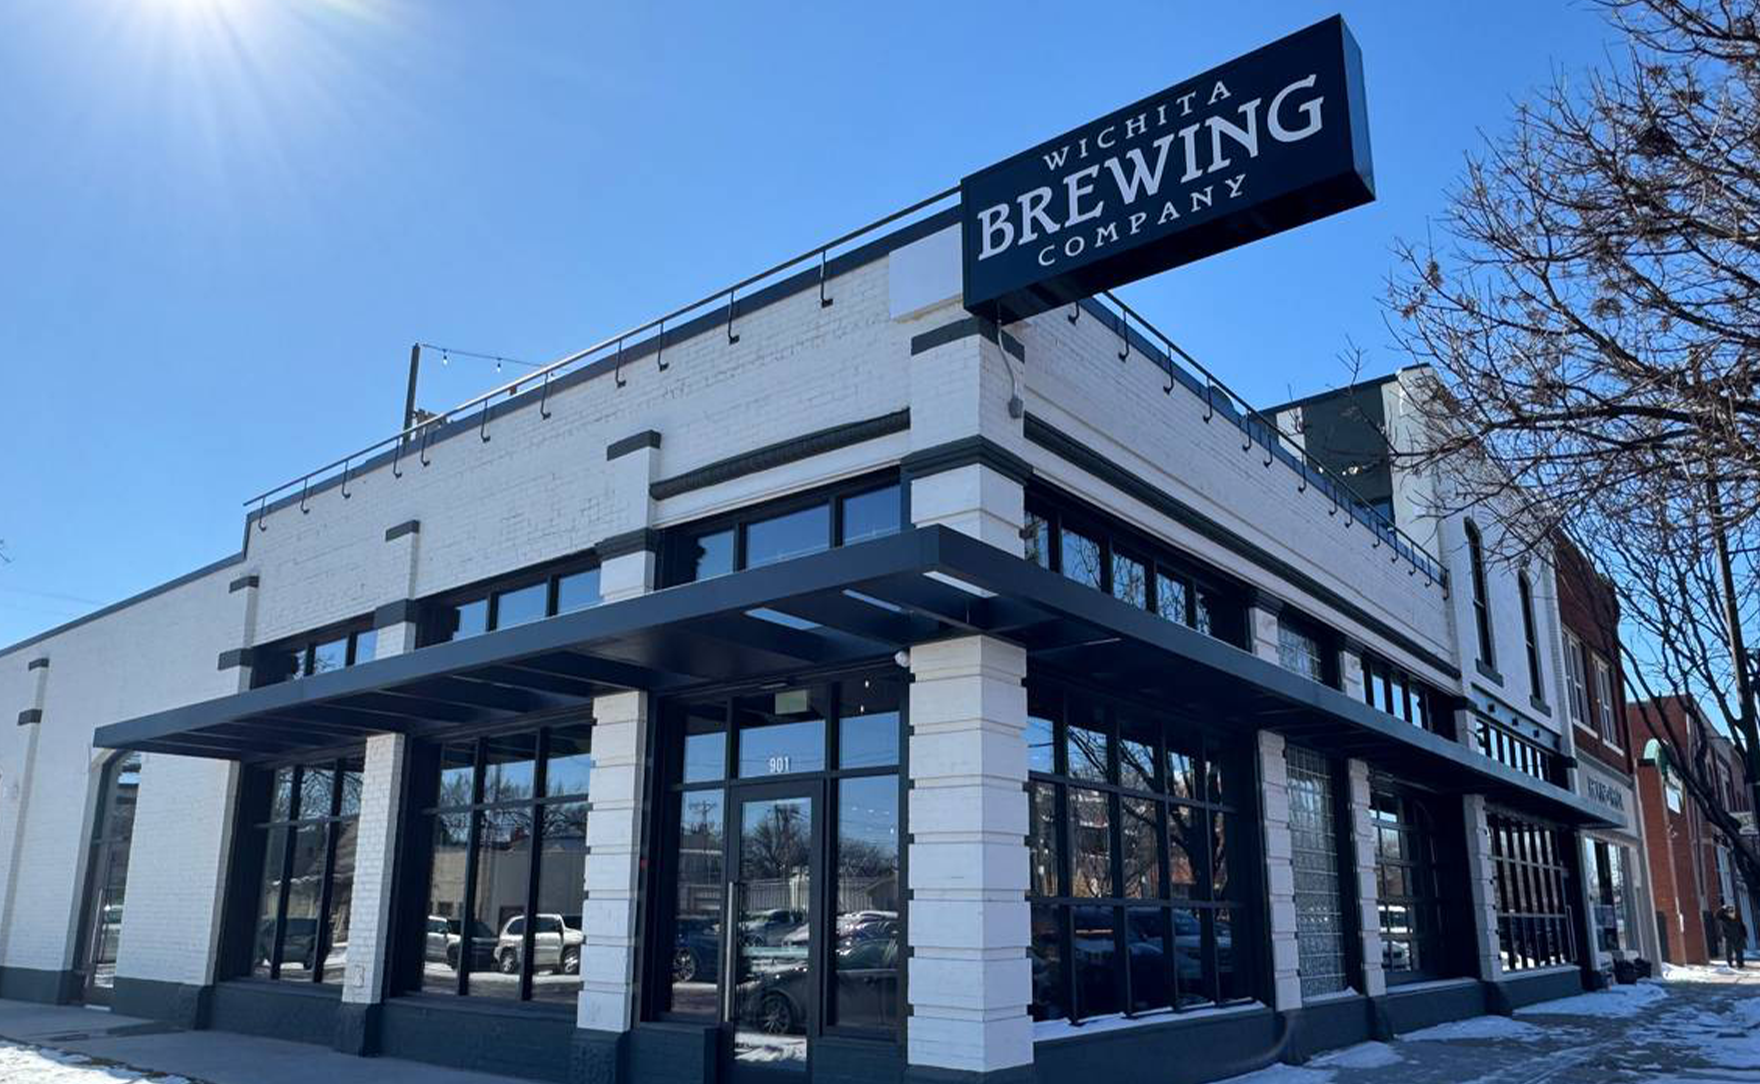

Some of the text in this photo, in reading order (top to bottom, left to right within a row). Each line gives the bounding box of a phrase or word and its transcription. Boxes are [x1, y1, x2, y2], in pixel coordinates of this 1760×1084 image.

[978, 74, 1324, 260] BREWING
[1043, 80, 1231, 171] WICHITA
[1038, 174, 1246, 267] COMPANY
[769, 756, 789, 773] 901
